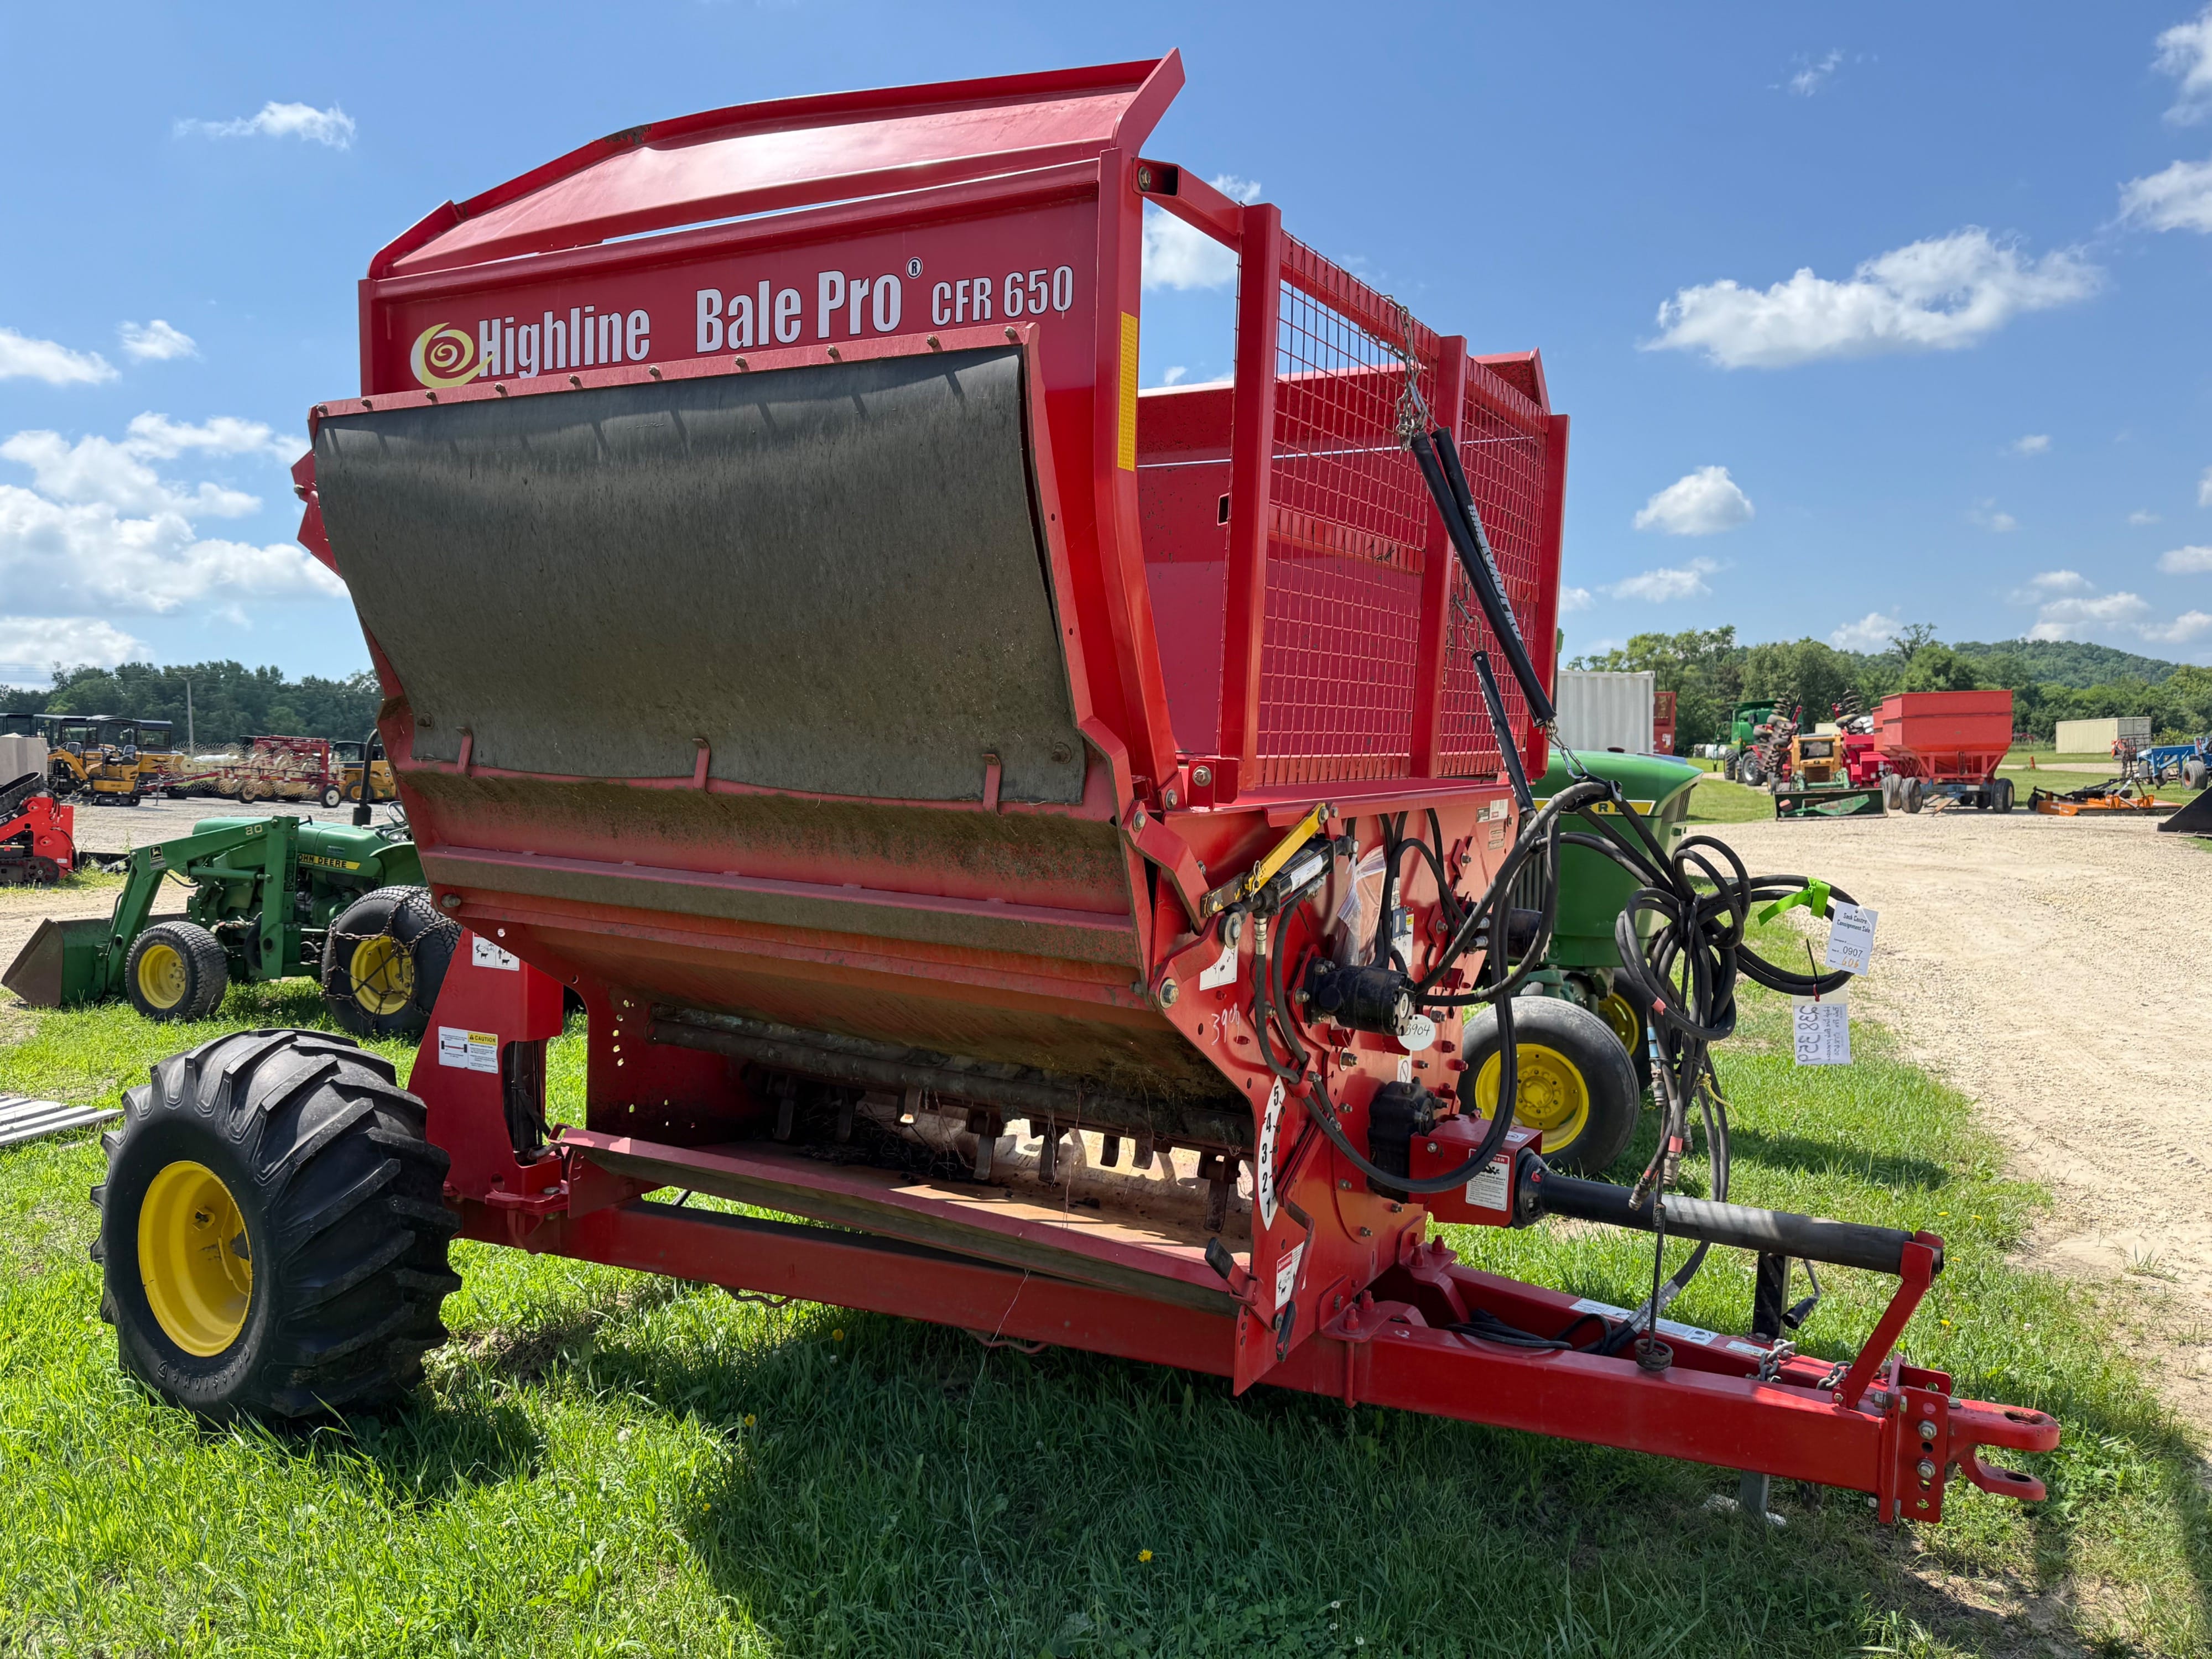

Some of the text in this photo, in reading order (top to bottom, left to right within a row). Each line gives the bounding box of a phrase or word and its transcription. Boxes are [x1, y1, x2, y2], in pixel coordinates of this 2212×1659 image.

[478, 305, 650, 379] Highline
[696, 279, 801, 353] Bale
[817, 270, 902, 339] Pro
[931, 277, 992, 326] CFR
[1003, 265, 1074, 318] 650
[245, 825, 263, 836] 80
[298, 853, 347, 868] OHN DEERE
[1843, 946, 1864, 958] 0907
[474, 1035, 496, 1043] CAUTION
[1405, 1023, 1431, 1037] 3904
[1273, 1085, 1279, 1107] 5
[1266, 1112, 1272, 1133] 4
[1261, 1142, 1268, 1164] 3
[1262, 1172, 1268, 1194] 2
[1266, 1197, 1271, 1218] 1
